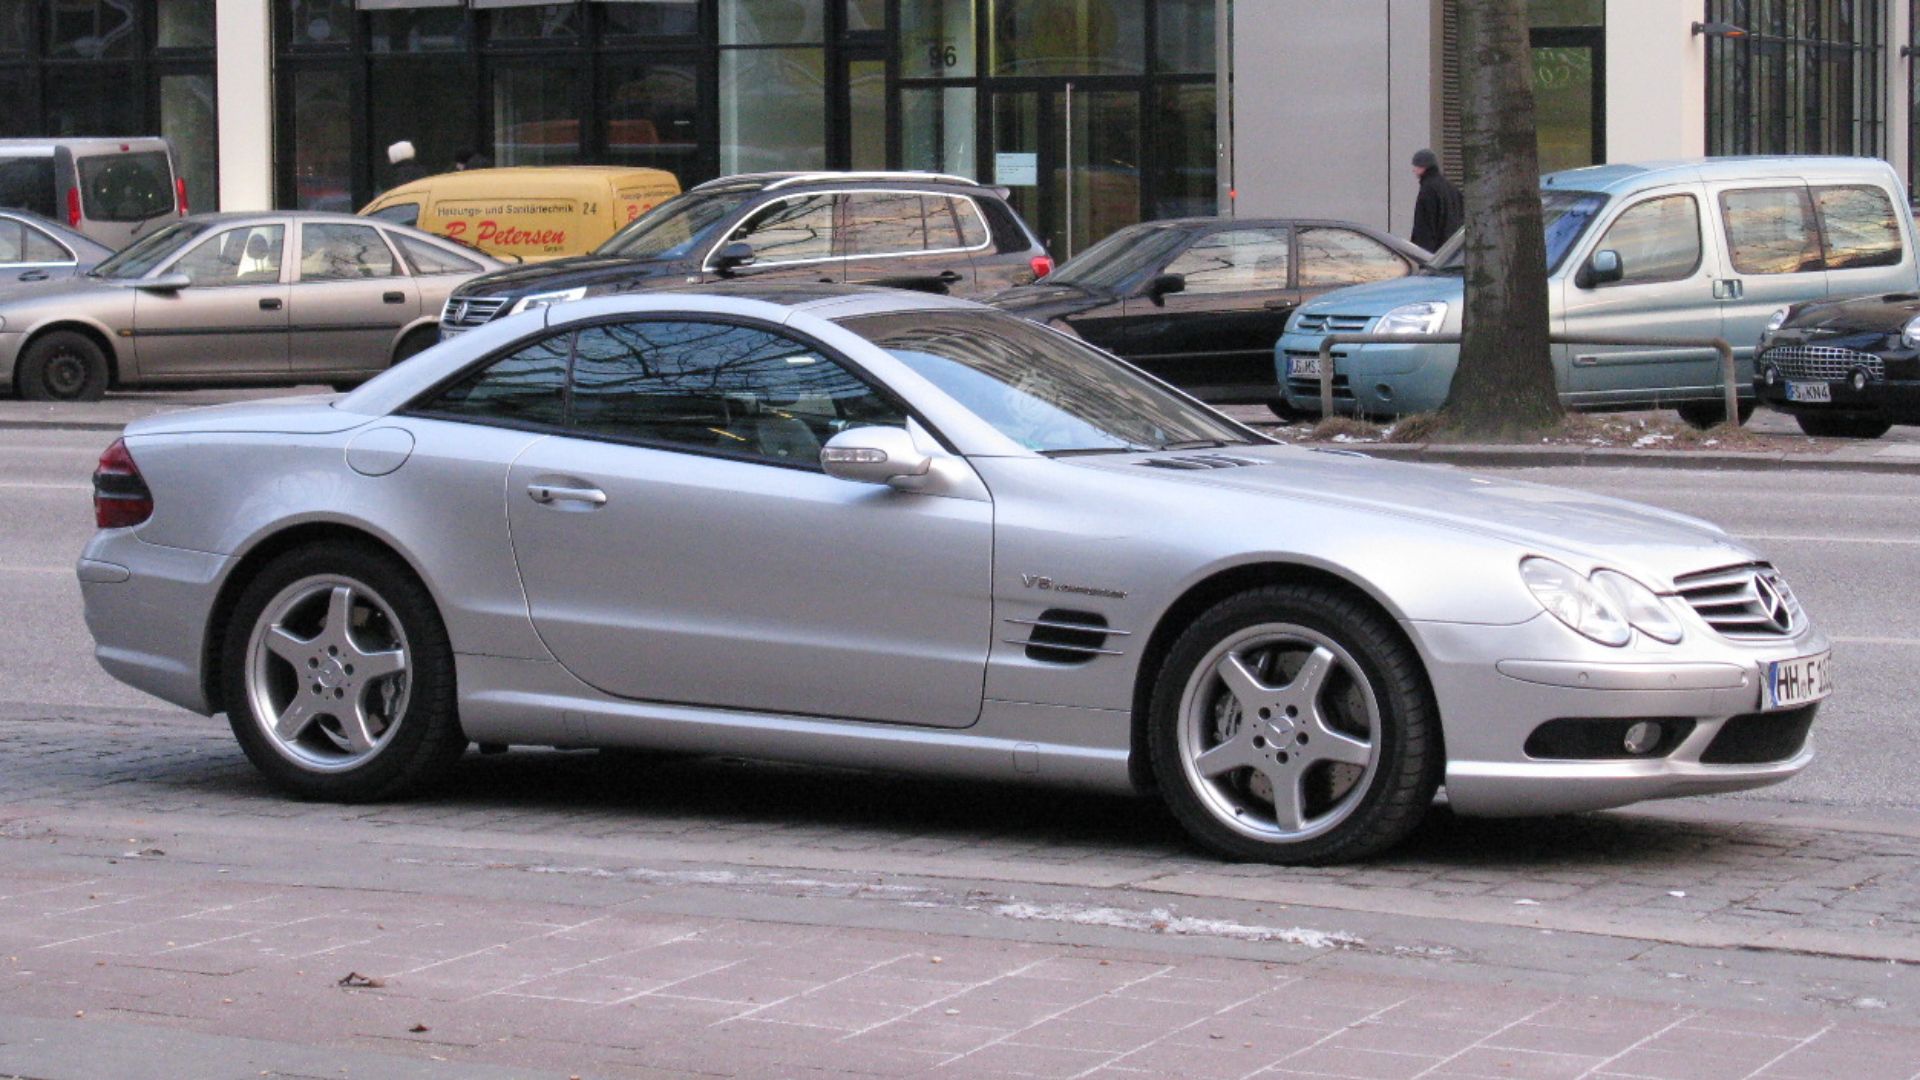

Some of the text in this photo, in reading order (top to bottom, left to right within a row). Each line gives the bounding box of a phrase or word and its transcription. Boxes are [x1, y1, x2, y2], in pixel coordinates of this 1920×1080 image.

[929, 45, 957, 67] 96
[485, 206, 503, 215] und
[582, 202, 597, 215] 24
[476, 220, 565, 246] Petersen
[1022, 573, 1052, 590] V8
[1777, 664, 1800, 701] HH
[1807, 661, 1815, 695] F
